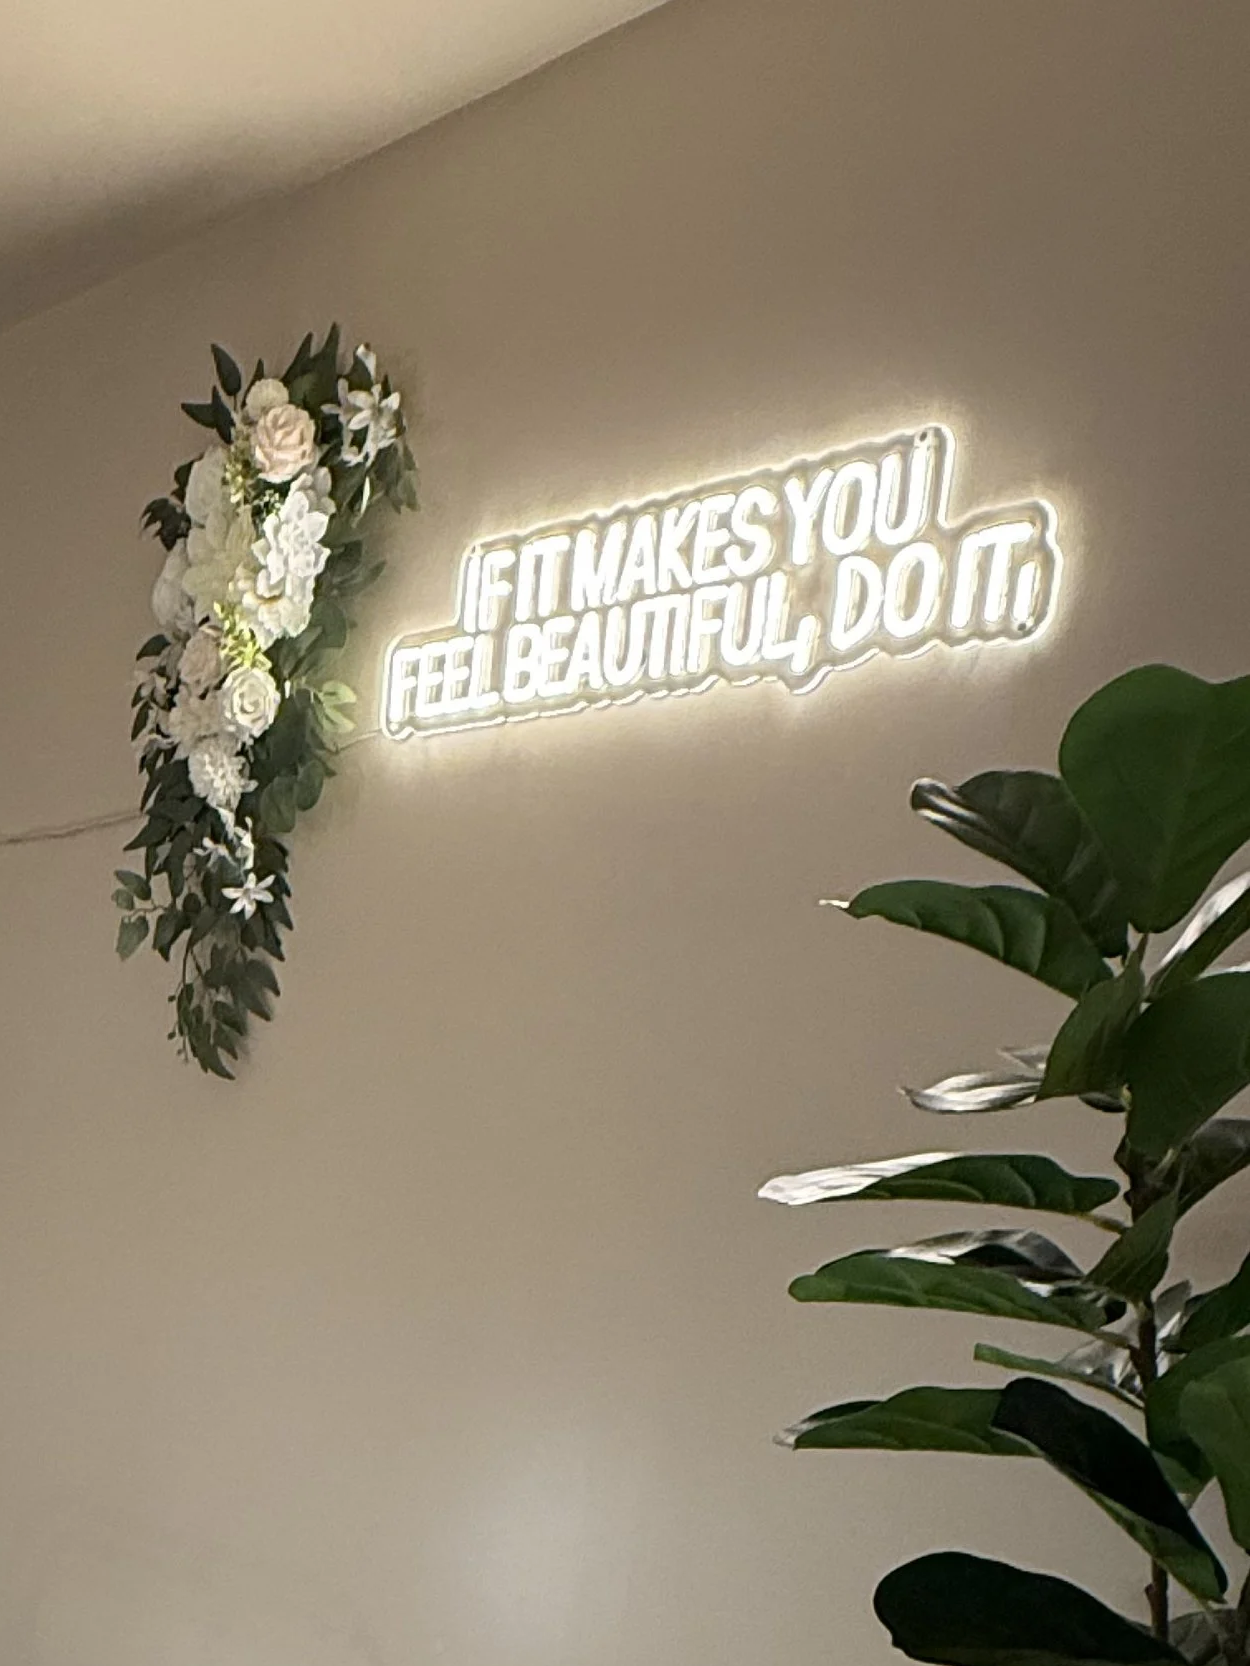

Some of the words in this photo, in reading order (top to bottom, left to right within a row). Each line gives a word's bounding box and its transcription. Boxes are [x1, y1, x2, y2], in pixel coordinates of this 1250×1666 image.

[388, 634, 501, 722] FEEL
[829, 540, 943, 653] DO
[461, 547, 516, 633] IF
[514, 533, 572, 623] IT
[570, 485, 778, 614] MAKES
[784, 447, 934, 567] YOU
